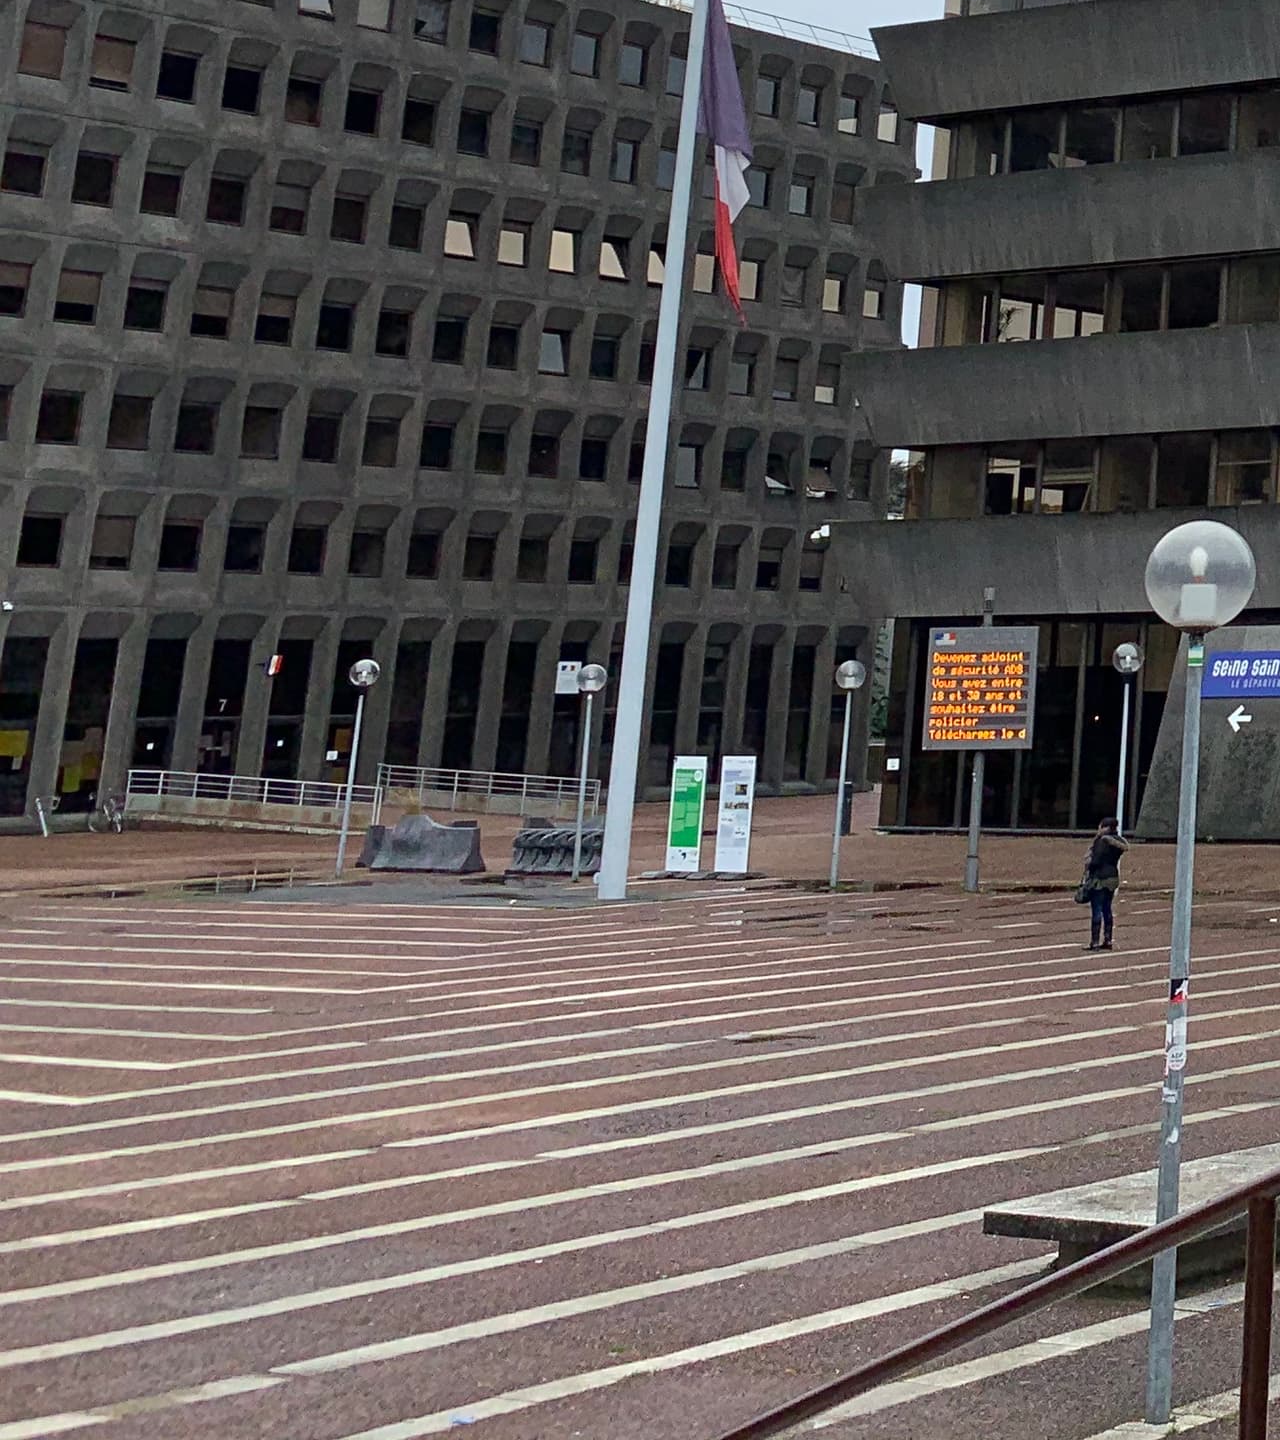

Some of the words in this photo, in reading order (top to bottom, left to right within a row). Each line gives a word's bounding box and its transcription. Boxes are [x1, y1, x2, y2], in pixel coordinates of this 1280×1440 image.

[933, 652, 977, 663] Devenez
[981, 652, 1024, 662] adjoint
[932, 665, 946, 676] de
[950, 664, 1000, 676] sécurité
[931, 678, 957, 688] Vous
[962, 679, 987, 688] avez
[991, 678, 1024, 688] entre
[1231, 680, 1240, 688] LE
[931, 691, 945, 701] 18
[949, 691, 962, 701] et
[967, 691, 980, 701] 30
[985, 691, 1004, 700] ans
[1008, 690, 1022, 700] et
[219, 698, 227, 712] 7
[930, 704, 986, 714] souhaitez
[989, 703, 1016, 713] être
[929, 717, 978, 727] policier
[928, 729, 996, 740] Téléchargez
[1001, 728, 1014, 739] le
